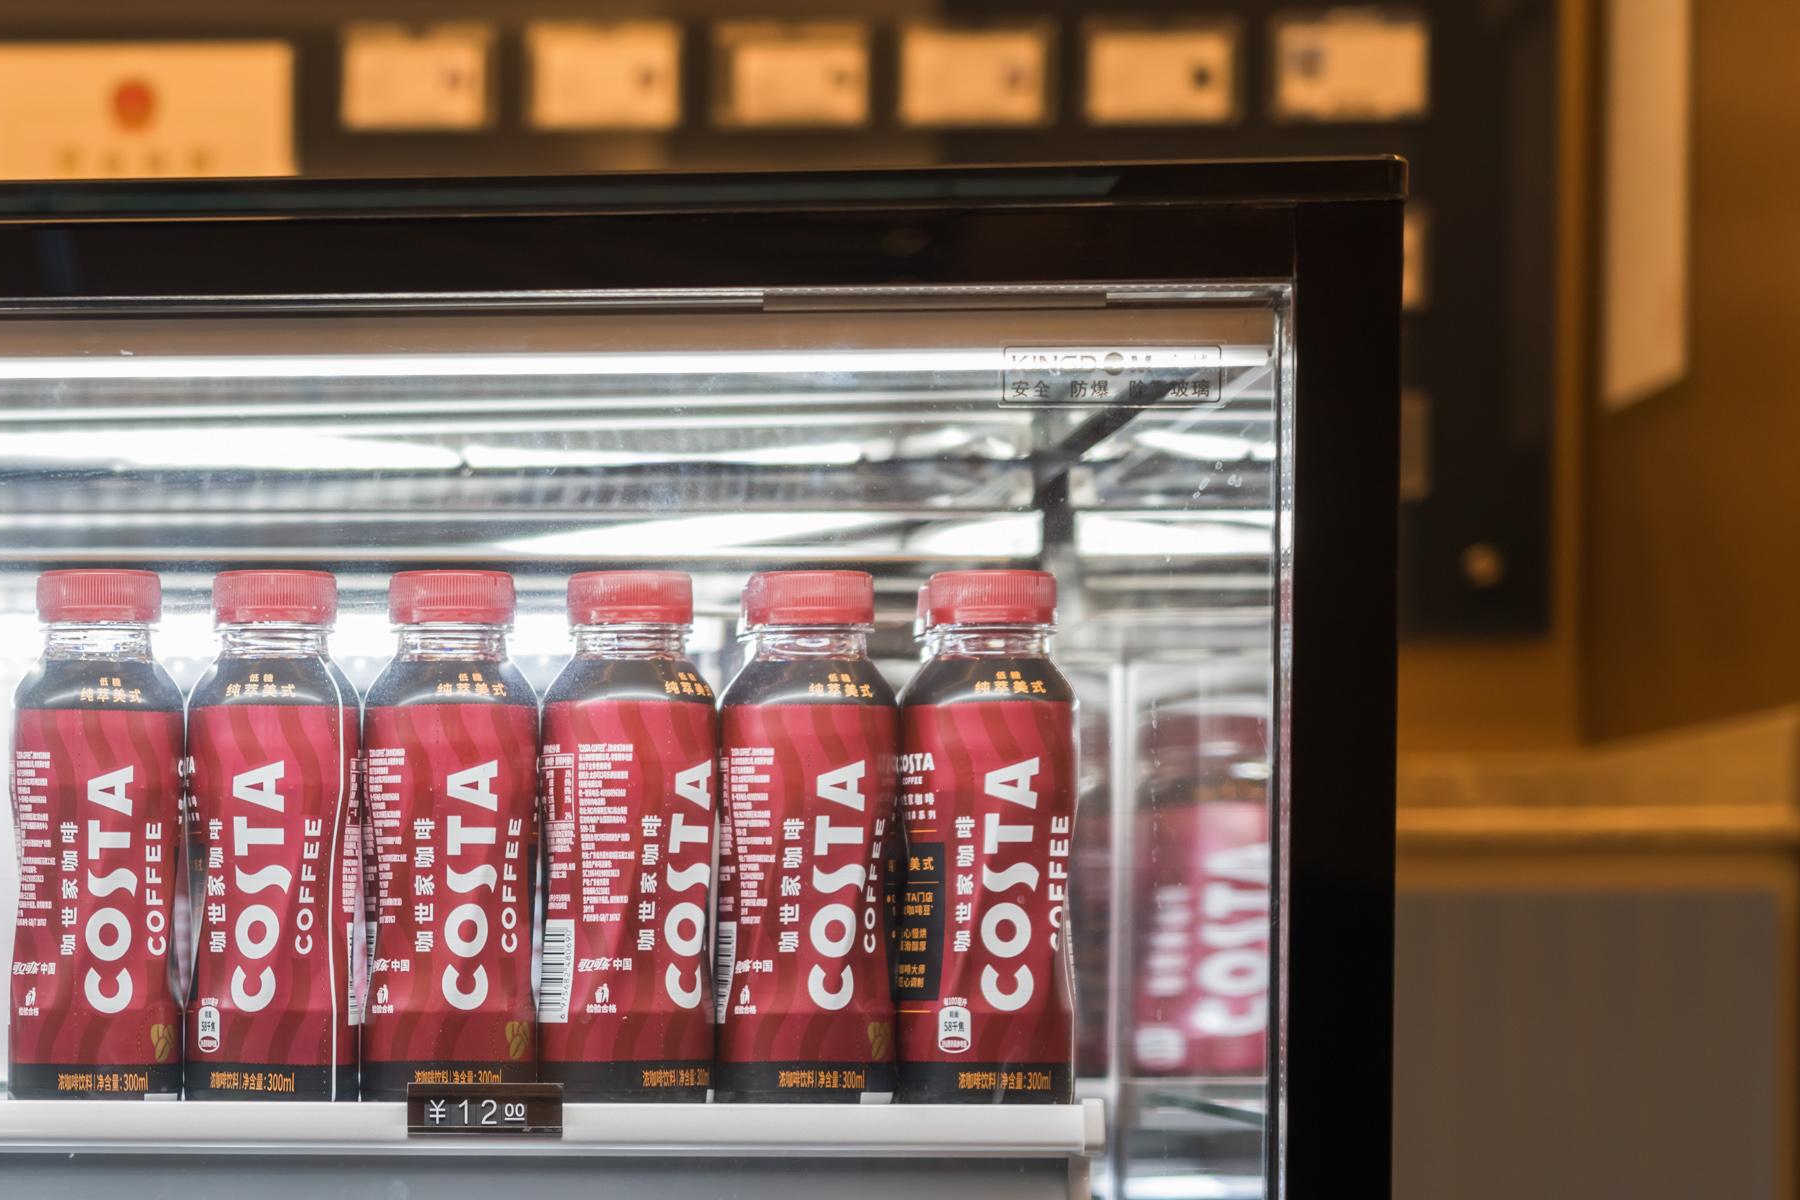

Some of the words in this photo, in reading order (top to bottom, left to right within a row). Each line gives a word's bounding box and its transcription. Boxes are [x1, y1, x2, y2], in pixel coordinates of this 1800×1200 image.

[1011, 380, 1050, 397] 安全
[1070, 380, 1109, 397] 防爆
[60, 821, 78, 956] 咖世家咖啡
[84, 765, 138, 1014] COSTA
[145, 822, 167, 956] COFFEE
[208, 818, 226, 953] 咖世家咖啡
[231, 759, 293, 1013] COSTA
[295, 818, 323, 955] COFFEE
[414, 817, 435, 953] 咖世家咖啡
[441, 759, 498, 1011] COSTA
[501, 818, 522, 953] COFFEE
[637, 815, 662, 951] 咖世家咖啡
[664, 759, 712, 1009] COSTA
[778, 818, 805, 953] 咖世家咖啡
[808, 759, 866, 1011] COSTA
[863, 818, 886, 953] COFFEE
[953, 815, 975, 952] 咖世家咖啡
[980, 756, 1040, 1012] COSTA
[586, 1003, 617, 1013] 检验合格
[944, 1021, 965, 1032] 58千焦
